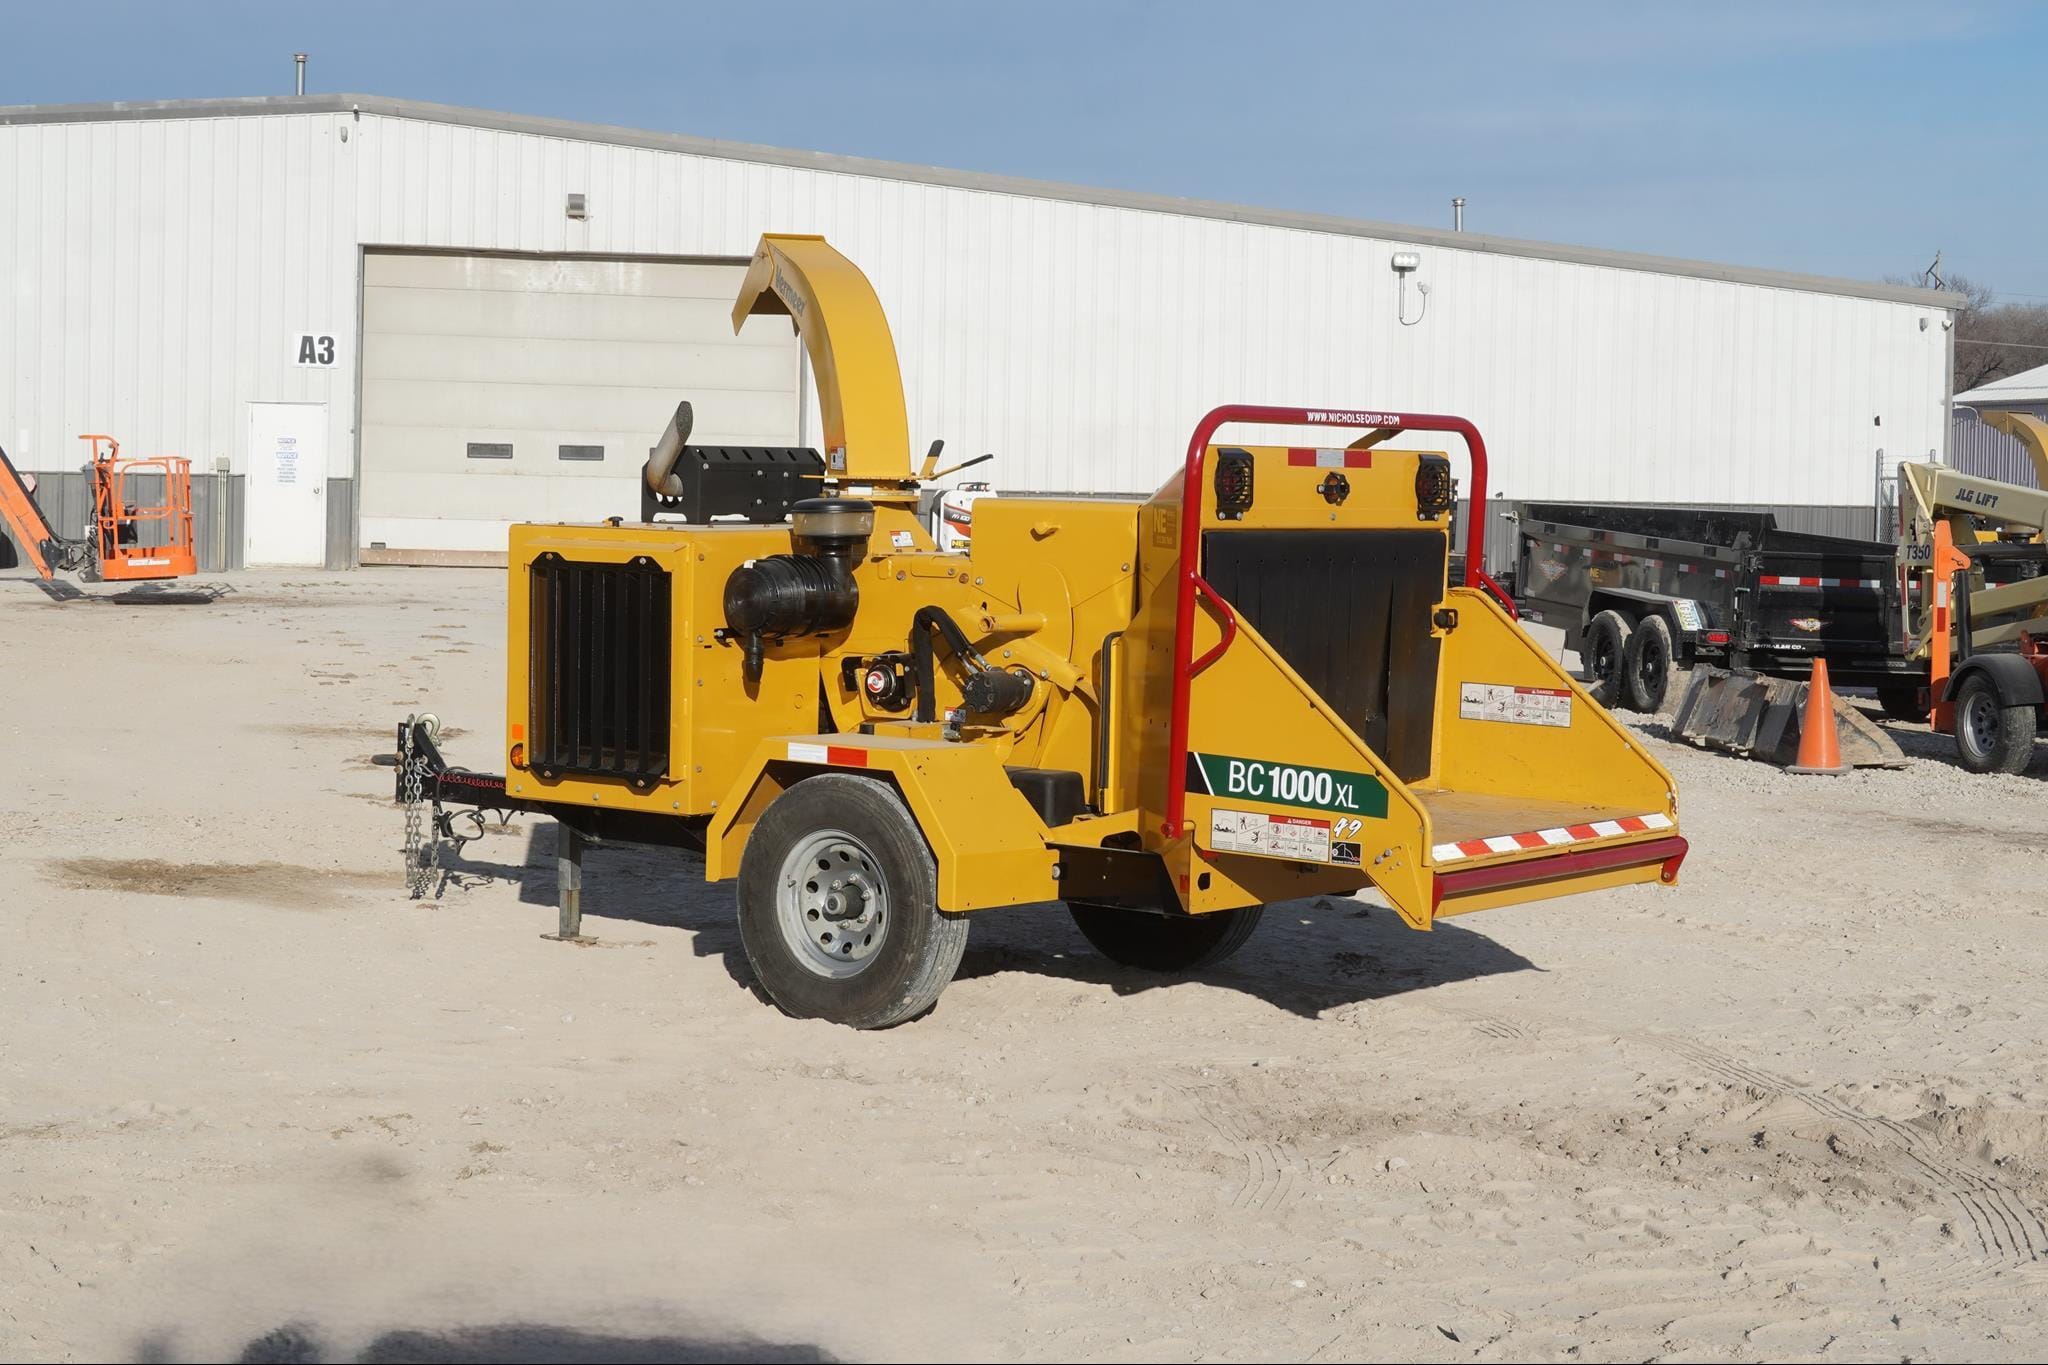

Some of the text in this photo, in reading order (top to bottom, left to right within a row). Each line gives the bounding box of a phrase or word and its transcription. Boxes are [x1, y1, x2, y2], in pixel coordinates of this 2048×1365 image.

[298, 335, 335, 365] A3
[1307, 411, 1400, 425] WWW.NICHOLSEQUIP.COM
[1955, 488, 1998, 508] JLG LIFT
[1906, 545, 1931, 560] T350
[1292, 818, 1312, 826] DANGER
